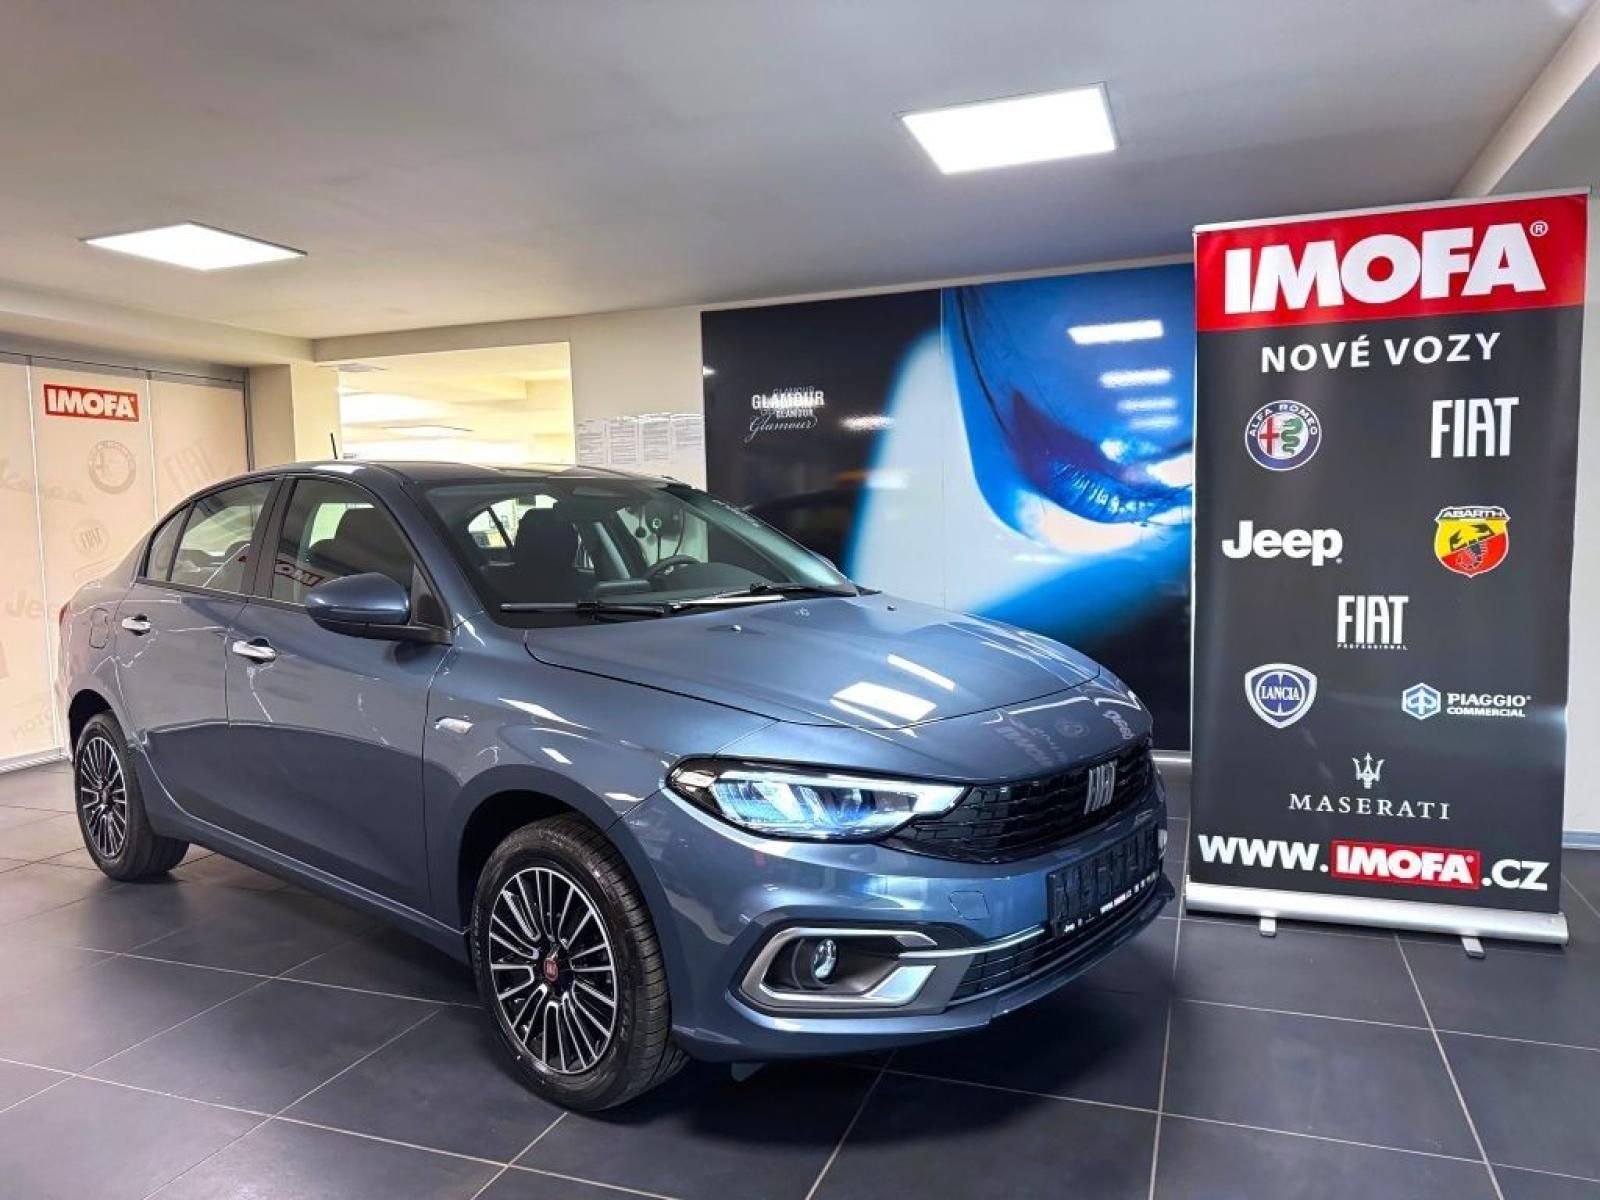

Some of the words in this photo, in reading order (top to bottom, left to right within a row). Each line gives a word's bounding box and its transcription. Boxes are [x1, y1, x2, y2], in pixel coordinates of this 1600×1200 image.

[1261, 335, 1370, 373] NOVÉ
[1384, 332, 1500, 365] VOZY
[47, 388, 136, 417] IMOFA
[1249, 408, 1273, 437] ALFA
[1279, 404, 1318, 435] ROMEO
[1430, 397, 1519, 459] FIAT
[1442, 509, 1504, 518] ABARTH
[1222, 520, 1343, 566] Jeep
[1337, 595, 1408, 644] FIAT
[1261, 685, 1300, 700] LANCIA
[1447, 692, 1526, 707] PIAGGIO
[1446, 707, 1525, 718] COMMERCIAL
[1289, 793, 1450, 820] MASERATI
